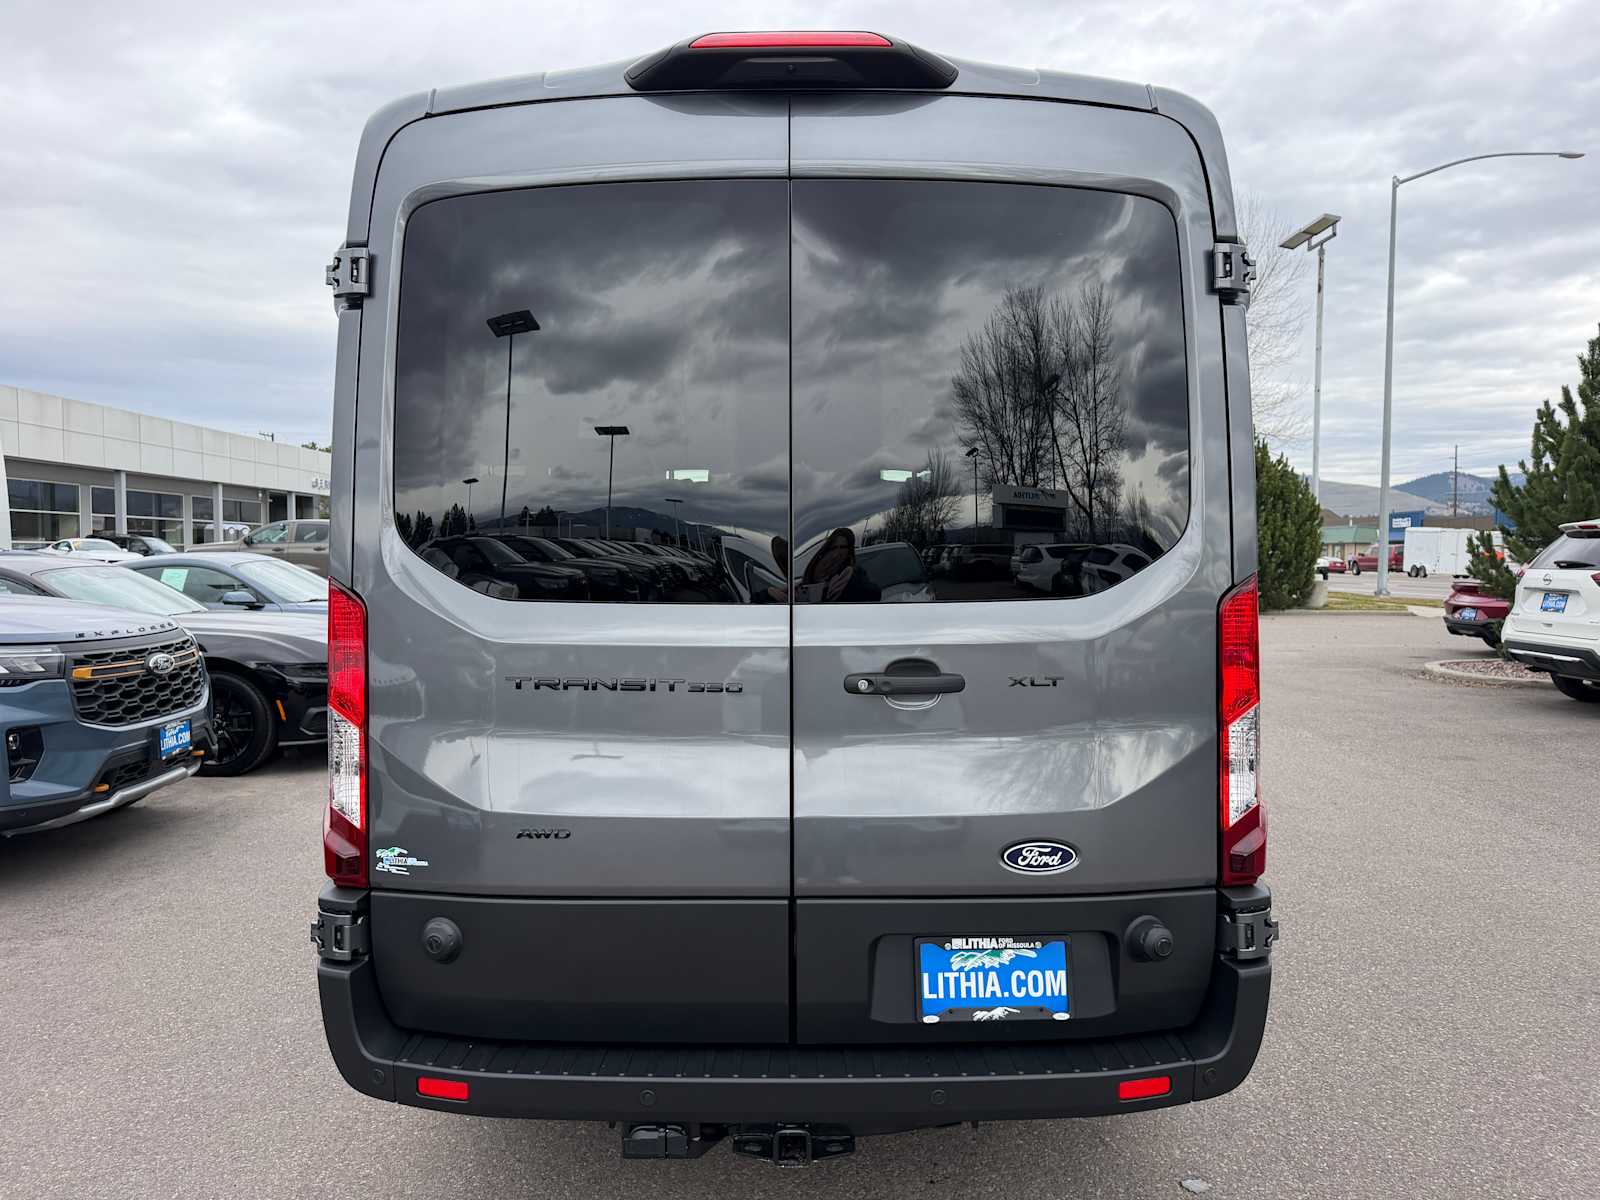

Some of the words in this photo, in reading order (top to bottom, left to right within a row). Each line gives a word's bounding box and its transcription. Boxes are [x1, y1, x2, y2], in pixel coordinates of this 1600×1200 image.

[75, 622, 173, 639] EXPLORER
[505, 676, 685, 692] TRANSIT
[687, 682, 743, 693] 350
[1008, 676, 1064, 687] XLT
[516, 828, 571, 839] AWD
[1017, 846, 1062, 866] Ford
[962, 938, 998, 949] LITHIA
[922, 970, 1067, 999] LITHIA.COM
